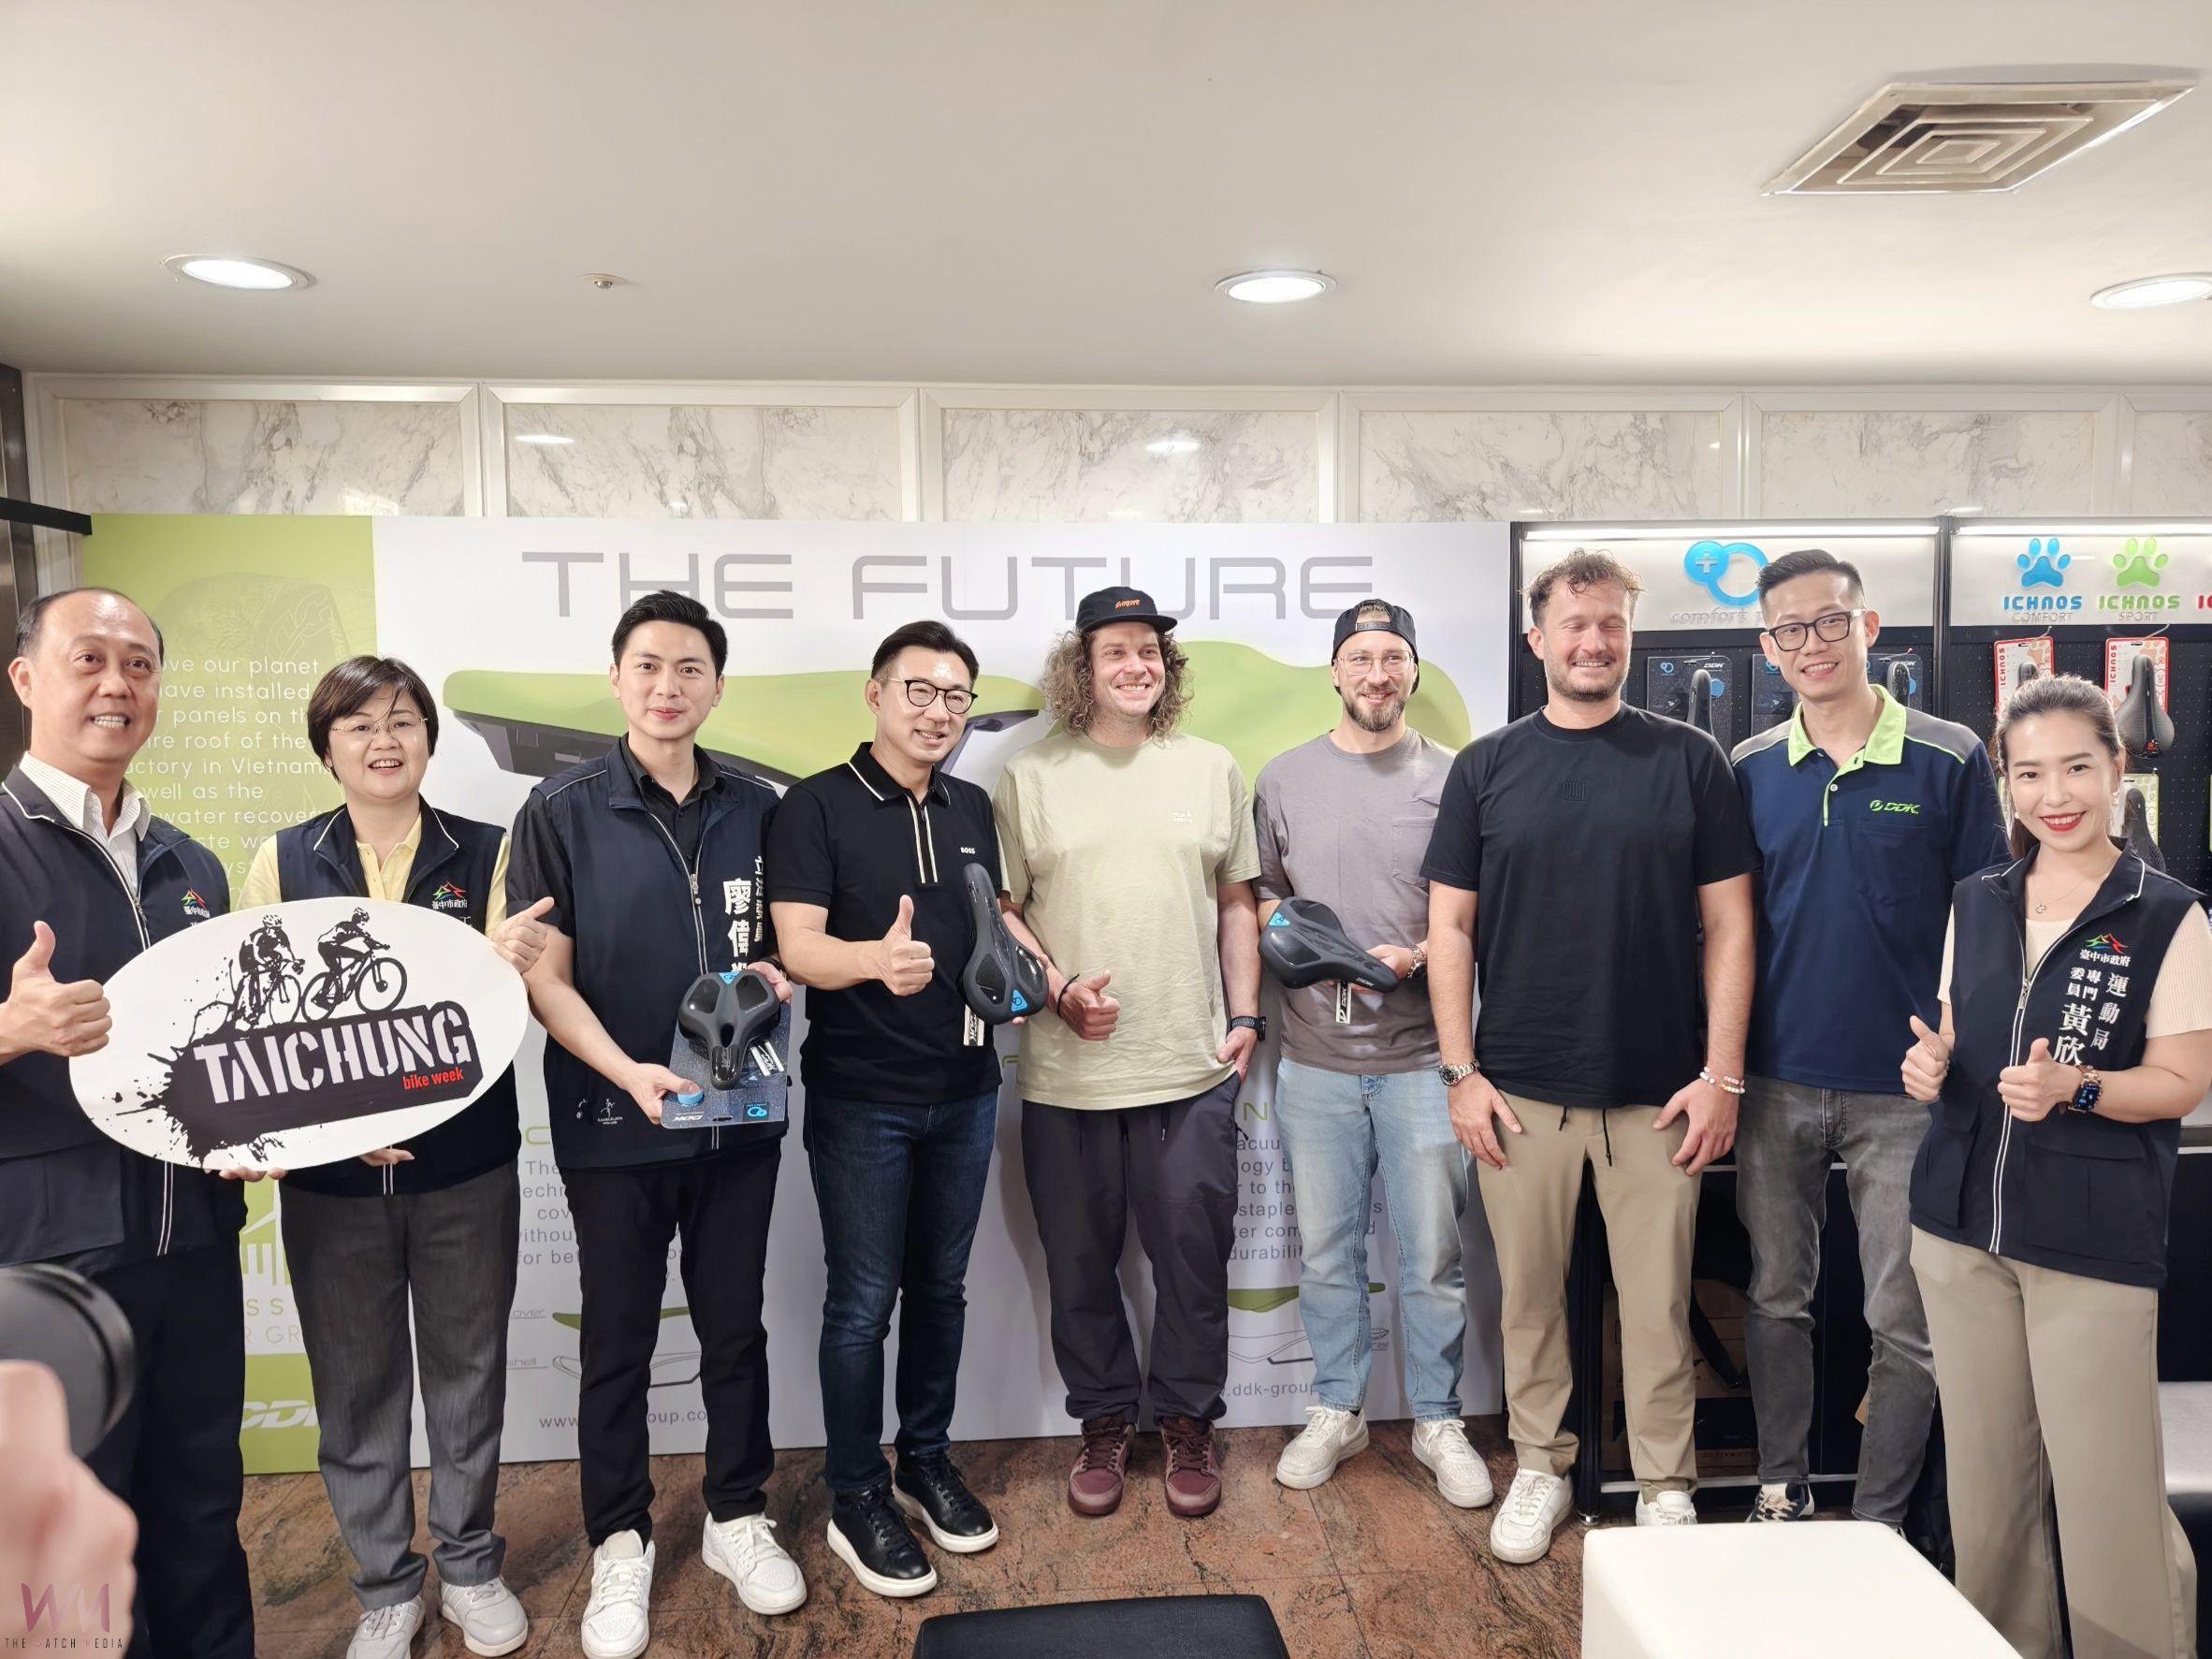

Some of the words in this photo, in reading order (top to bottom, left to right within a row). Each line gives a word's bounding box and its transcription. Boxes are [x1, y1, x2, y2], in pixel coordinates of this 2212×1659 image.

[523, 552, 793, 619] THE
[852, 554, 1374, 621] FUTURE
[2003, 595, 2083, 610] ICHNOS
[2099, 595, 2181, 610] ICHNOS
[1669, 607, 1748, 625] comfort
[2012, 612, 2074, 623] COMFORT
[2117, 611, 2160, 622] SPORT
[204, 659, 240, 673] our
[214, 682, 311, 700] installed
[173, 707, 247, 726] panels
[255, 710, 281, 723] on
[185, 732, 231, 749] roof
[240, 732, 262, 749] of
[272, 733, 307, 749] the
[203, 760, 222, 774] in
[142, 782, 181, 800] well
[193, 787, 218, 799] as
[227, 784, 263, 799] the
[1885, 802, 1921, 814] DDK
[164, 810, 226, 824] water
[960, 846, 976, 854] BOSS
[2079, 948, 2132, 968] 臺中市政府
[2089, 972, 2131, 1051] 運動局
[195, 1007, 473, 1105] TAICHUNG
[403, 1069, 429, 1090] bike
[430, 1067, 464, 1086] week
[1250, 1182, 1267, 1194] to
[520, 1228, 573, 1243] ithou
